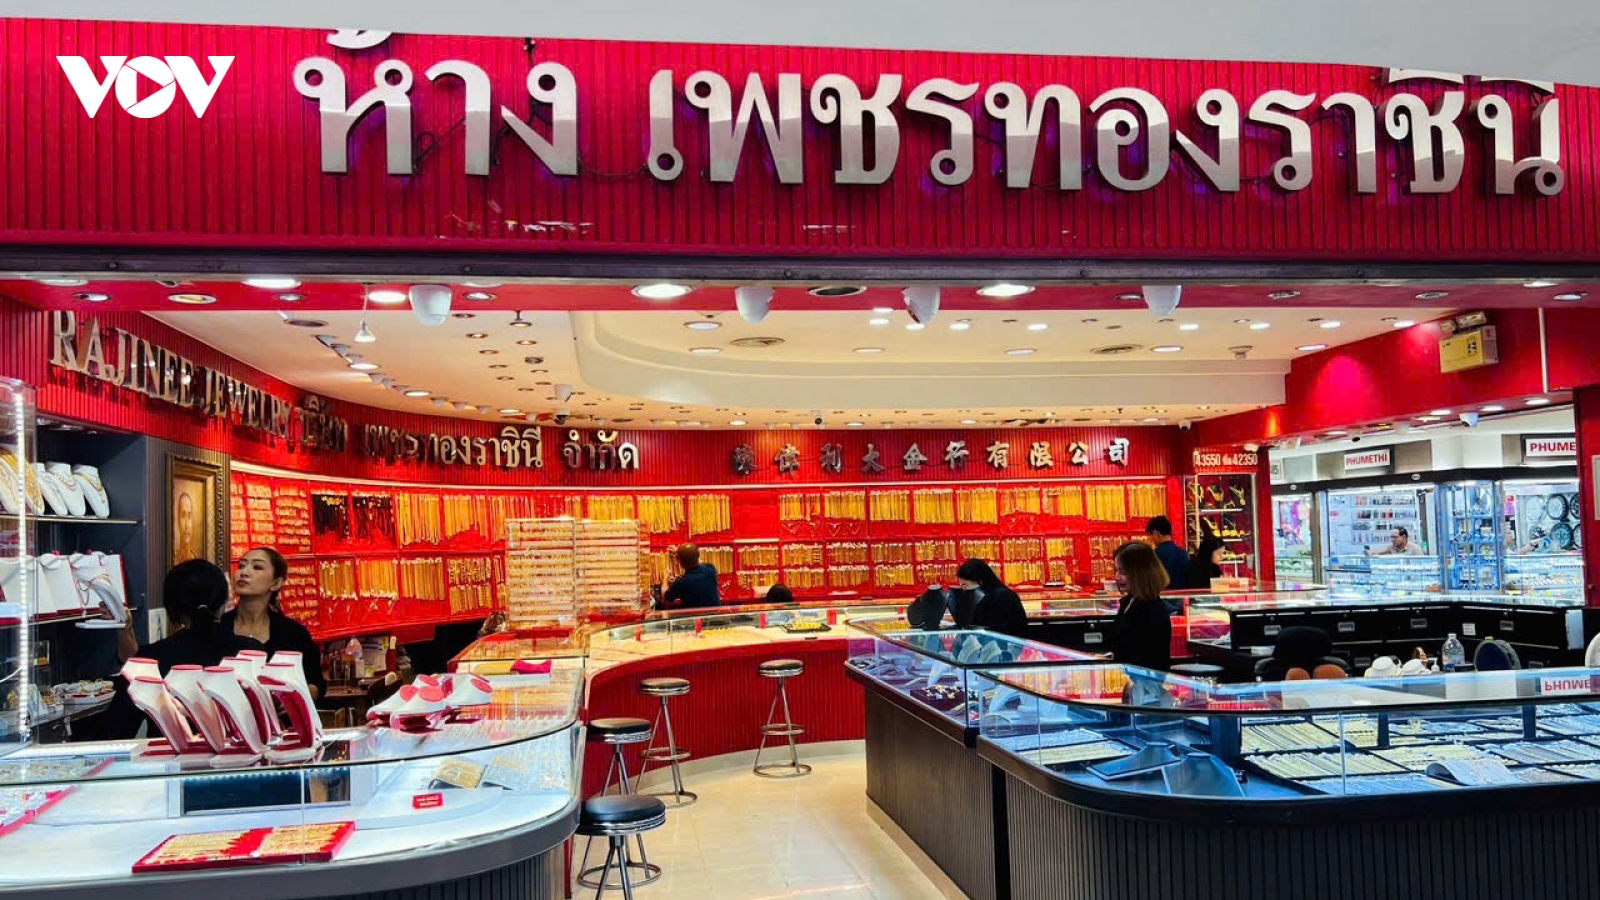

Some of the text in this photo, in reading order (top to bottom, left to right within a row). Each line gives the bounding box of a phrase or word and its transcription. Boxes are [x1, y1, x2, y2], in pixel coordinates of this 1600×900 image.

[49, 310, 291, 442] RAJINEE JEWELRY
[563, 429, 640, 470] จำกัด
[1346, 453, 1388, 465] PHUMETHI
